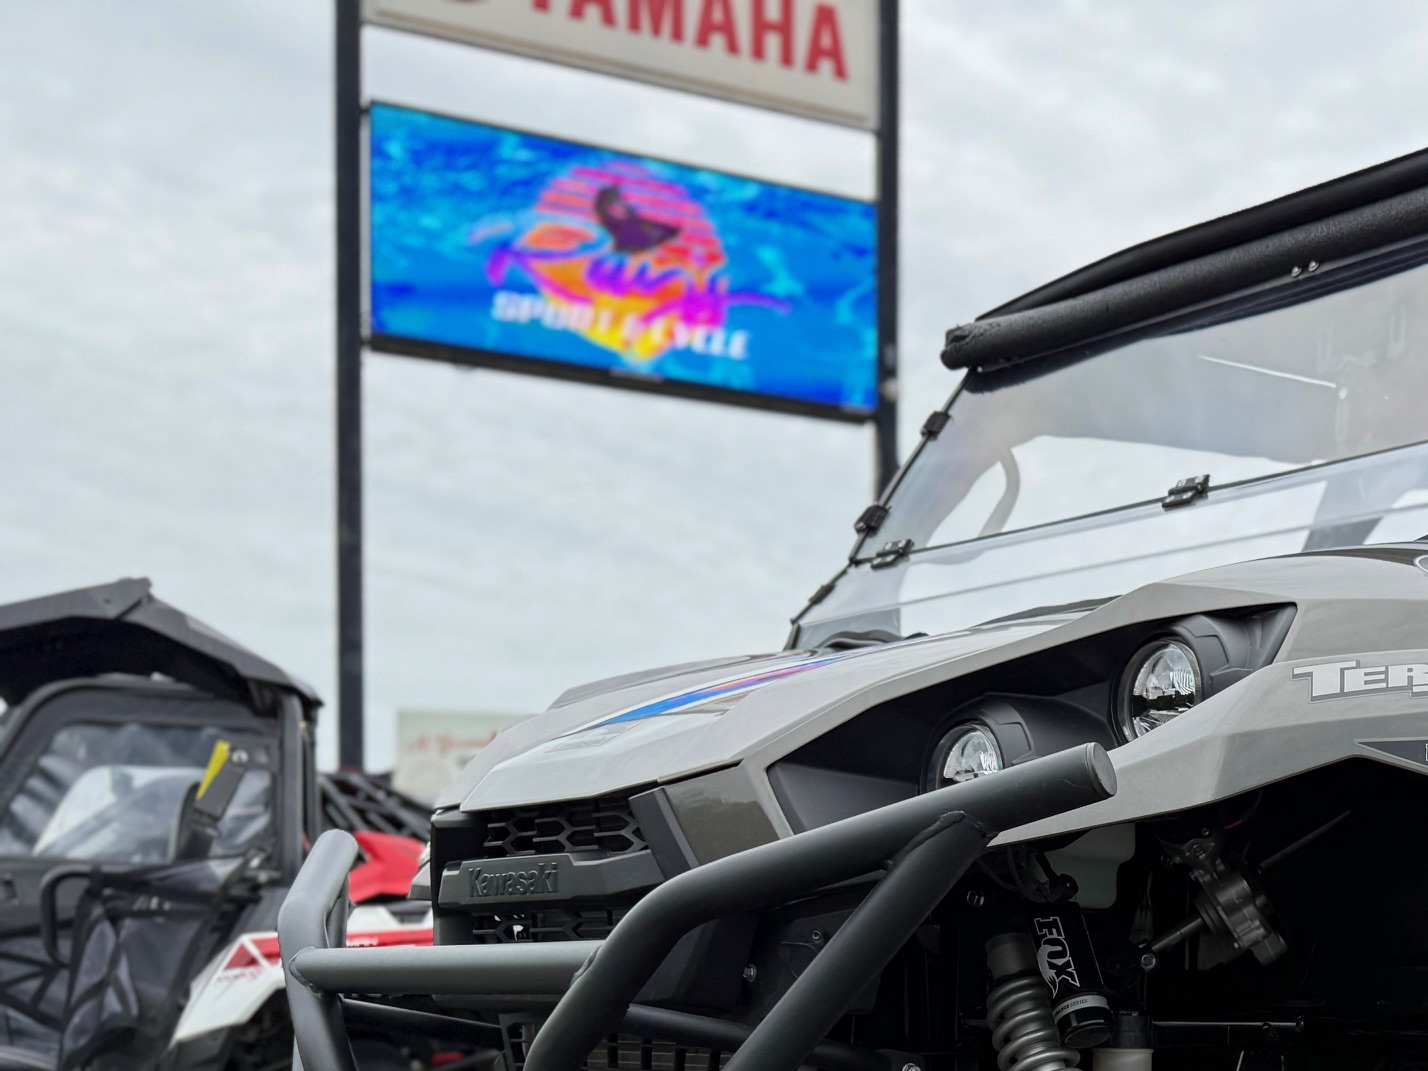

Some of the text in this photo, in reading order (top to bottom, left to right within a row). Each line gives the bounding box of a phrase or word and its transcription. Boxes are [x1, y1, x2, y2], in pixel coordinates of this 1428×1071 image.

[532, 0, 848, 81] MAHA
[468, 862, 558, 897] Kawasaki
[1034, 917, 1080, 990] FOX
